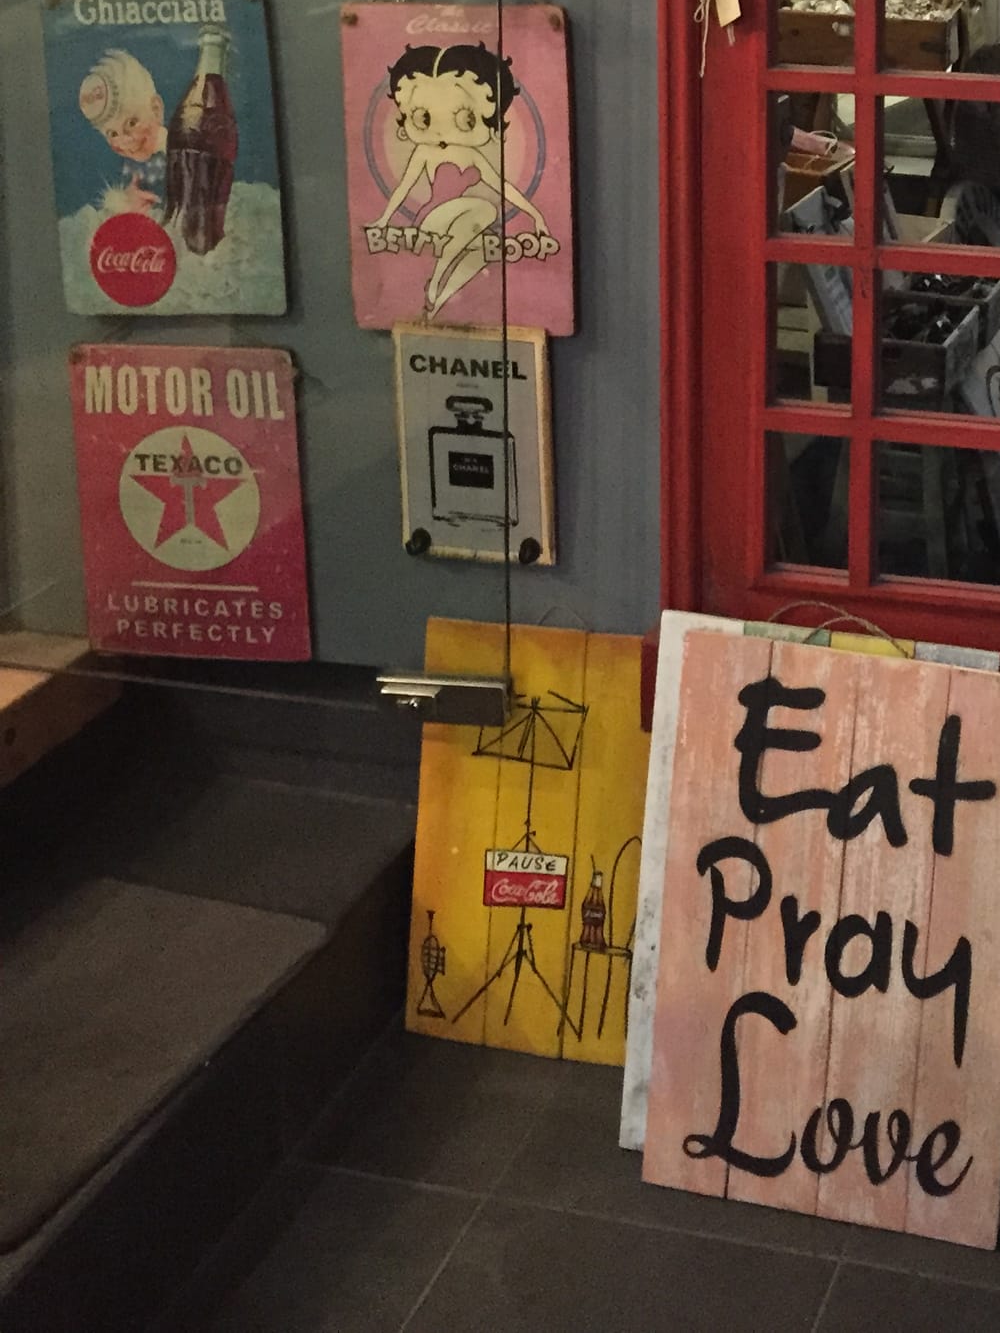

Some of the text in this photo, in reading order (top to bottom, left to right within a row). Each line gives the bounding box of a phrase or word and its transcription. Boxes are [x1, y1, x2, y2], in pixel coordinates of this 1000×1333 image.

[364, 226, 561, 263] BETTY BOOP
[409, 353, 528, 380] CHANEL
[84, 364, 285, 420] MOTOR OIL
[135, 453, 244, 476] TEXACO
[107, 593, 283, 619] LUBRICATES
[116, 619, 276, 644] PERFECTLY
[734, 676, 997, 857] Eat
[496, 852, 557, 872] PAUSE
[696, 836, 972, 1068] Pray
[682, 991, 973, 1198] Love
